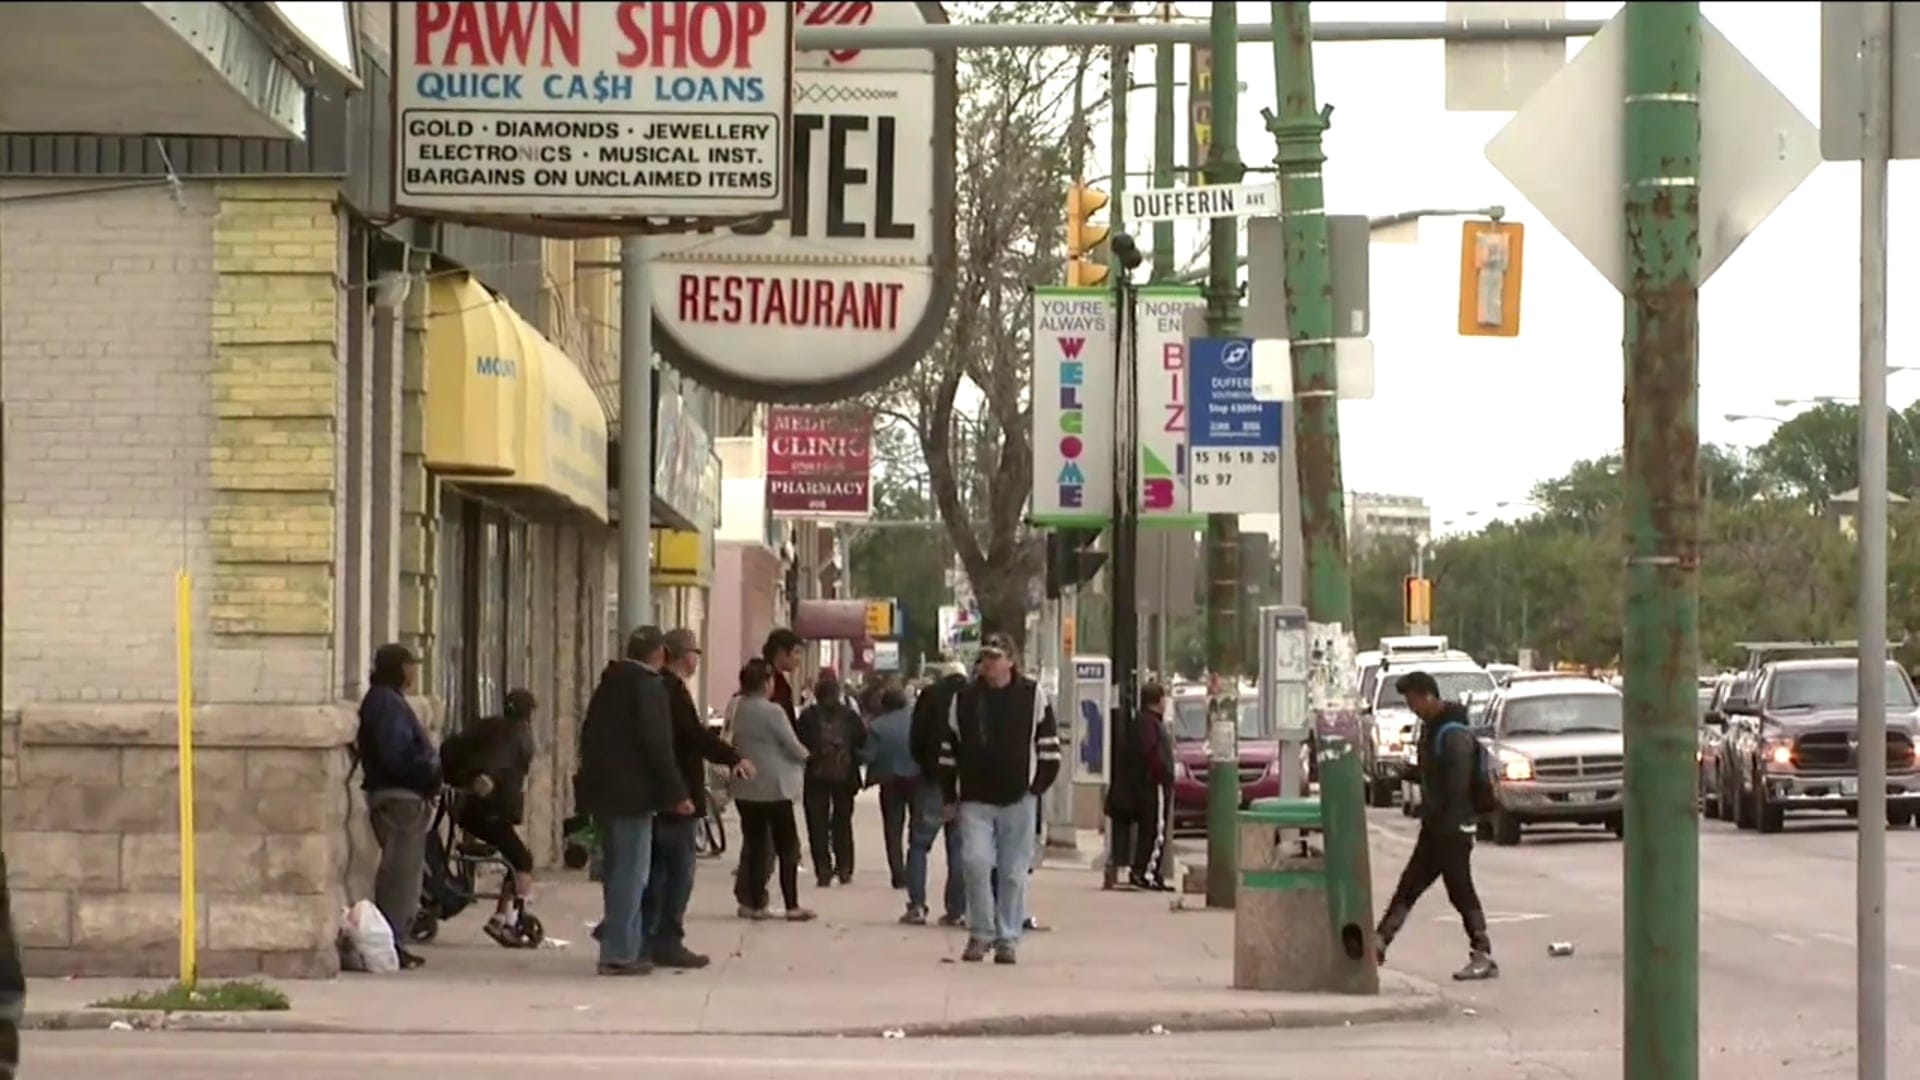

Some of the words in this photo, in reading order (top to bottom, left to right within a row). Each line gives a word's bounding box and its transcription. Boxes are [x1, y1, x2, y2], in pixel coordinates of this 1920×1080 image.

[414, 2, 580, 67] PAWN
[616, 2, 767, 68] SHOP
[416, 72, 523, 99] QUICK
[543, 70, 633, 101] CA$H
[655, 76, 765, 102] LOANS
[409, 120, 474, 138] GOLD
[495, 121, 620, 139] DIAMONDS
[643, 123, 770, 140] JEWELLERY
[419, 145, 572, 163] ELECTRONICS
[599, 146, 700, 164] MUSICAL
[708, 148, 763, 164] INST.
[406, 168, 525, 186] BARGAINS
[534, 169, 567, 186] ON
[575, 170, 702, 188] UNCLAIMED
[709, 171, 773, 188] ITEMS
[1133, 189, 1235, 218] DUFFERIN
[1246, 192, 1266, 206] AVE
[678, 274, 904, 331] RESTAURANT
[1041, 301, 1103, 316] YOU'RE
[1039, 317, 1106, 332] ALWAYS
[1157, 318, 1180, 333] EN
[1163, 342, 1186, 433] BIZ
[1057, 337, 1086, 508] WELCOME
[772, 436, 866, 457] CLINIC
[1195, 452, 1209, 464] 15
[1218, 452, 1232, 464] 16
[1239, 452, 1254, 464] 18
[1262, 452, 1277, 464] 20
[771, 481, 865, 495] PHARMACY
[1194, 473, 1209, 485] 45
[1216, 473, 1232, 485] 97
